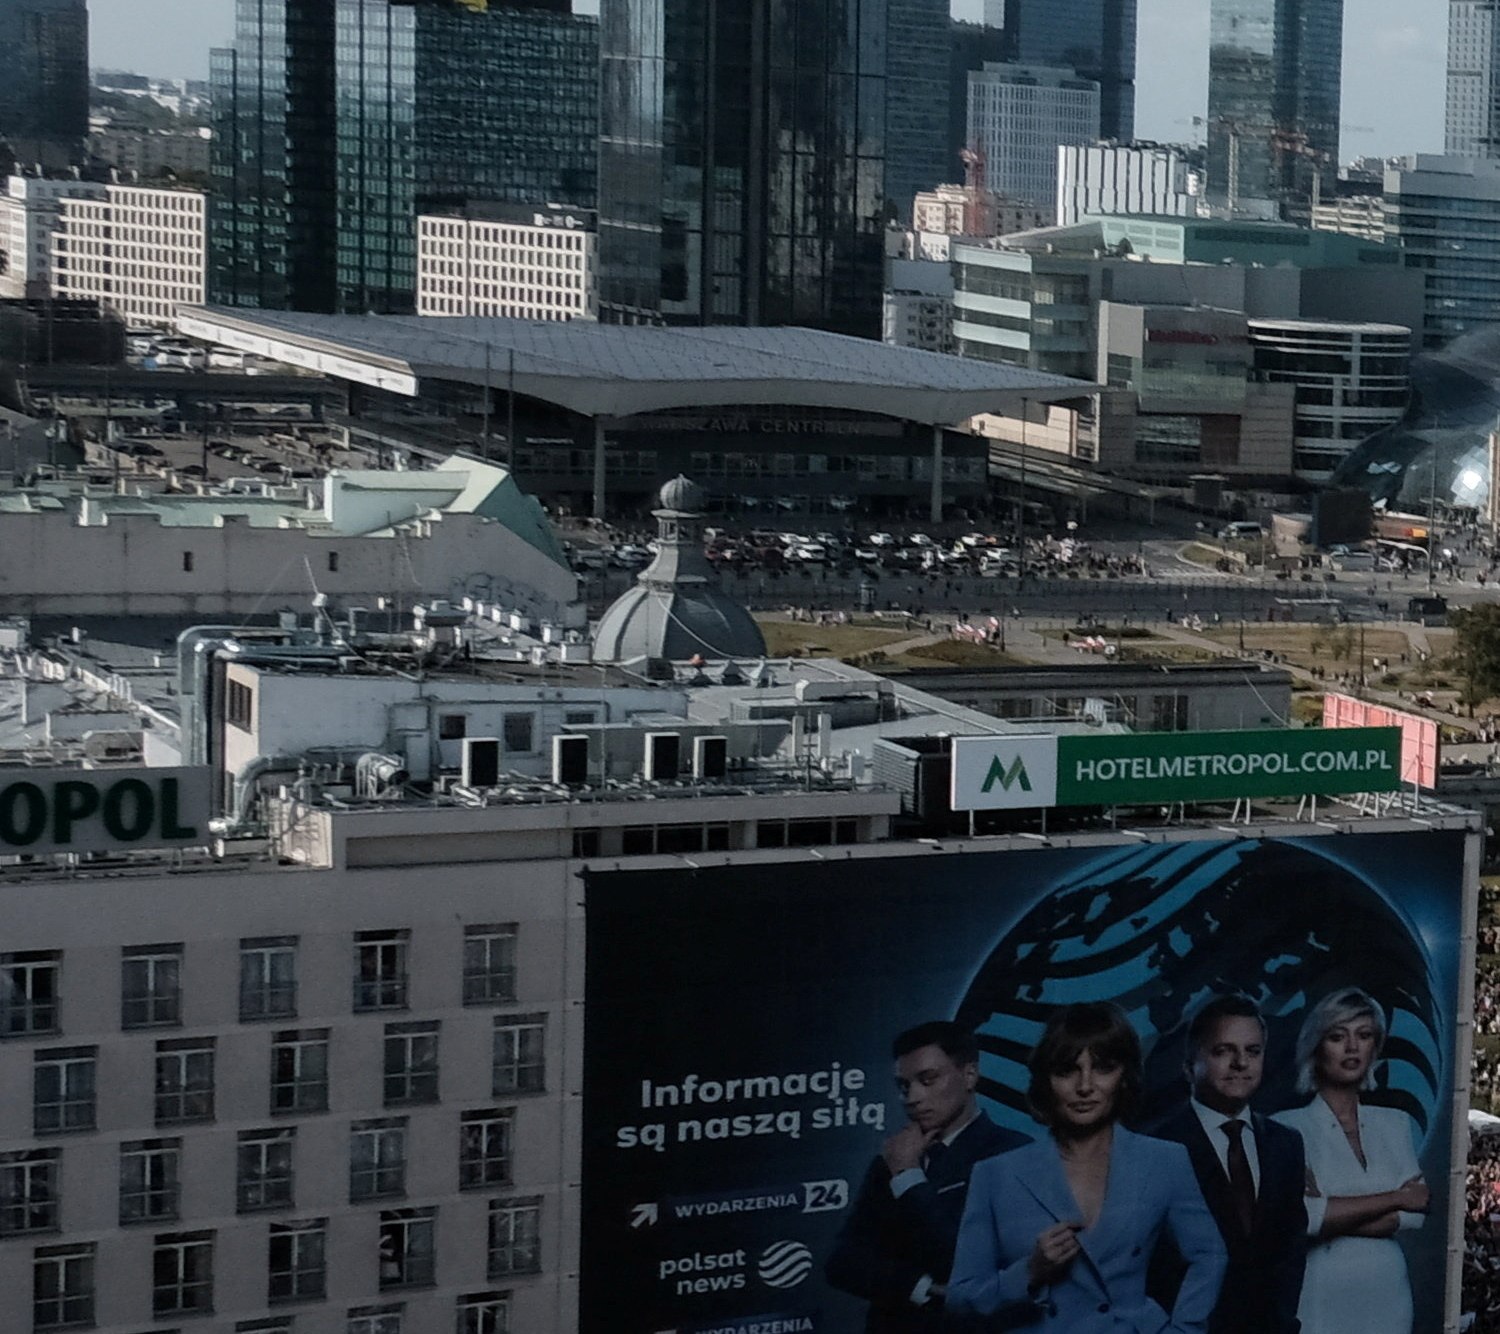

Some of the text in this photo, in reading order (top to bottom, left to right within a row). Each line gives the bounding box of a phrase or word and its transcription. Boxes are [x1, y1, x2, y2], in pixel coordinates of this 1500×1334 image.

[1076, 750, 1392, 782] HOTELMETROPOL.COM.PL
[641, 1061, 866, 1109] Informacje
[617, 1097, 886, 1152] są naszą siłą
[674, 1193, 798, 1219] WYDARZENIA
[660, 1248, 746, 1279] polsat
[677, 1273, 746, 1296] news
